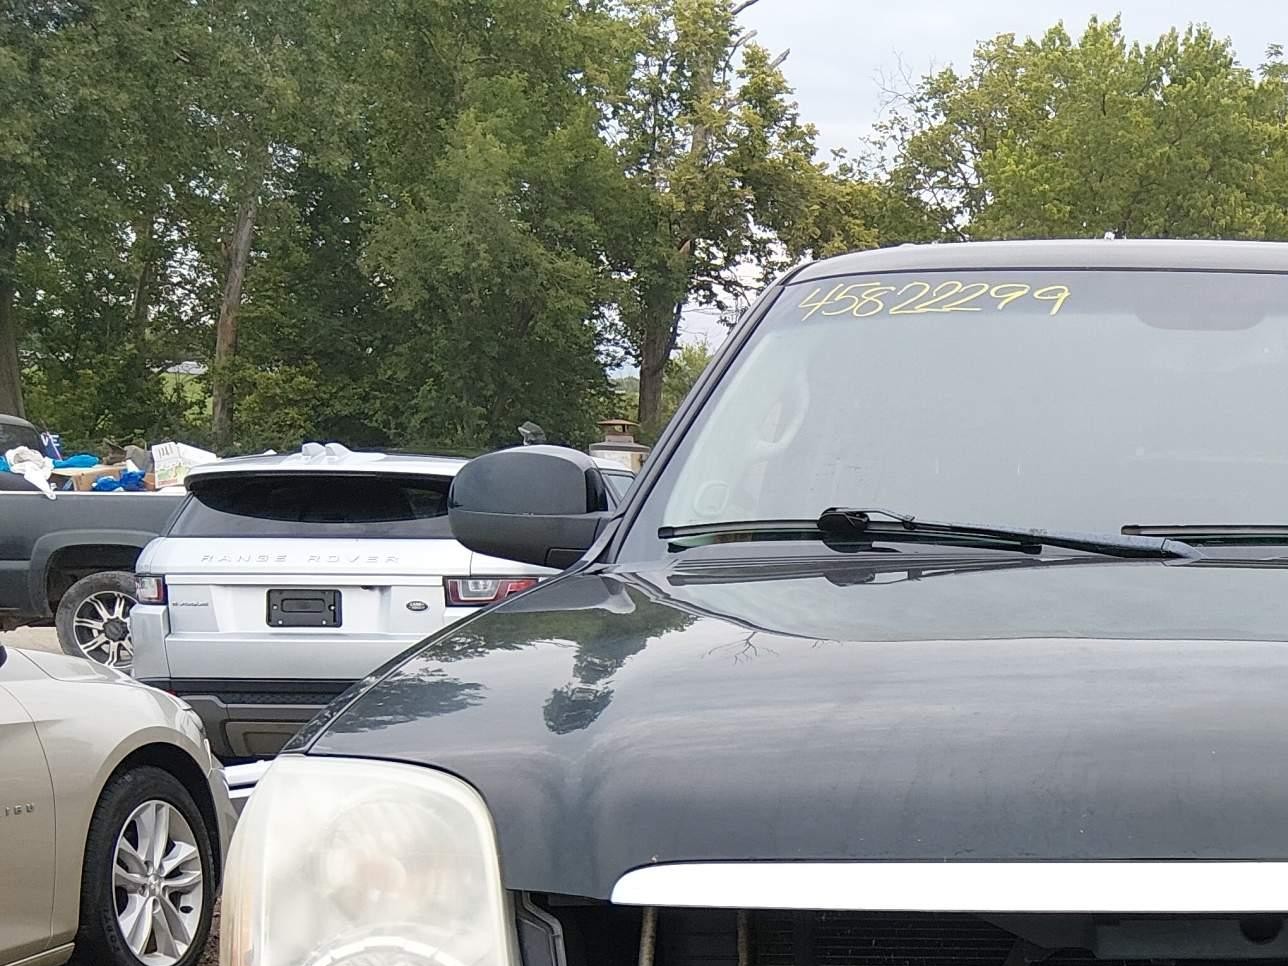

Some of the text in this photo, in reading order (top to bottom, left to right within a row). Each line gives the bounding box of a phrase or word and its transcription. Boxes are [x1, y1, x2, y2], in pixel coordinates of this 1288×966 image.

[798, 280, 1072, 321] 45822299
[201, 553, 401, 563] RANGE ROVER
